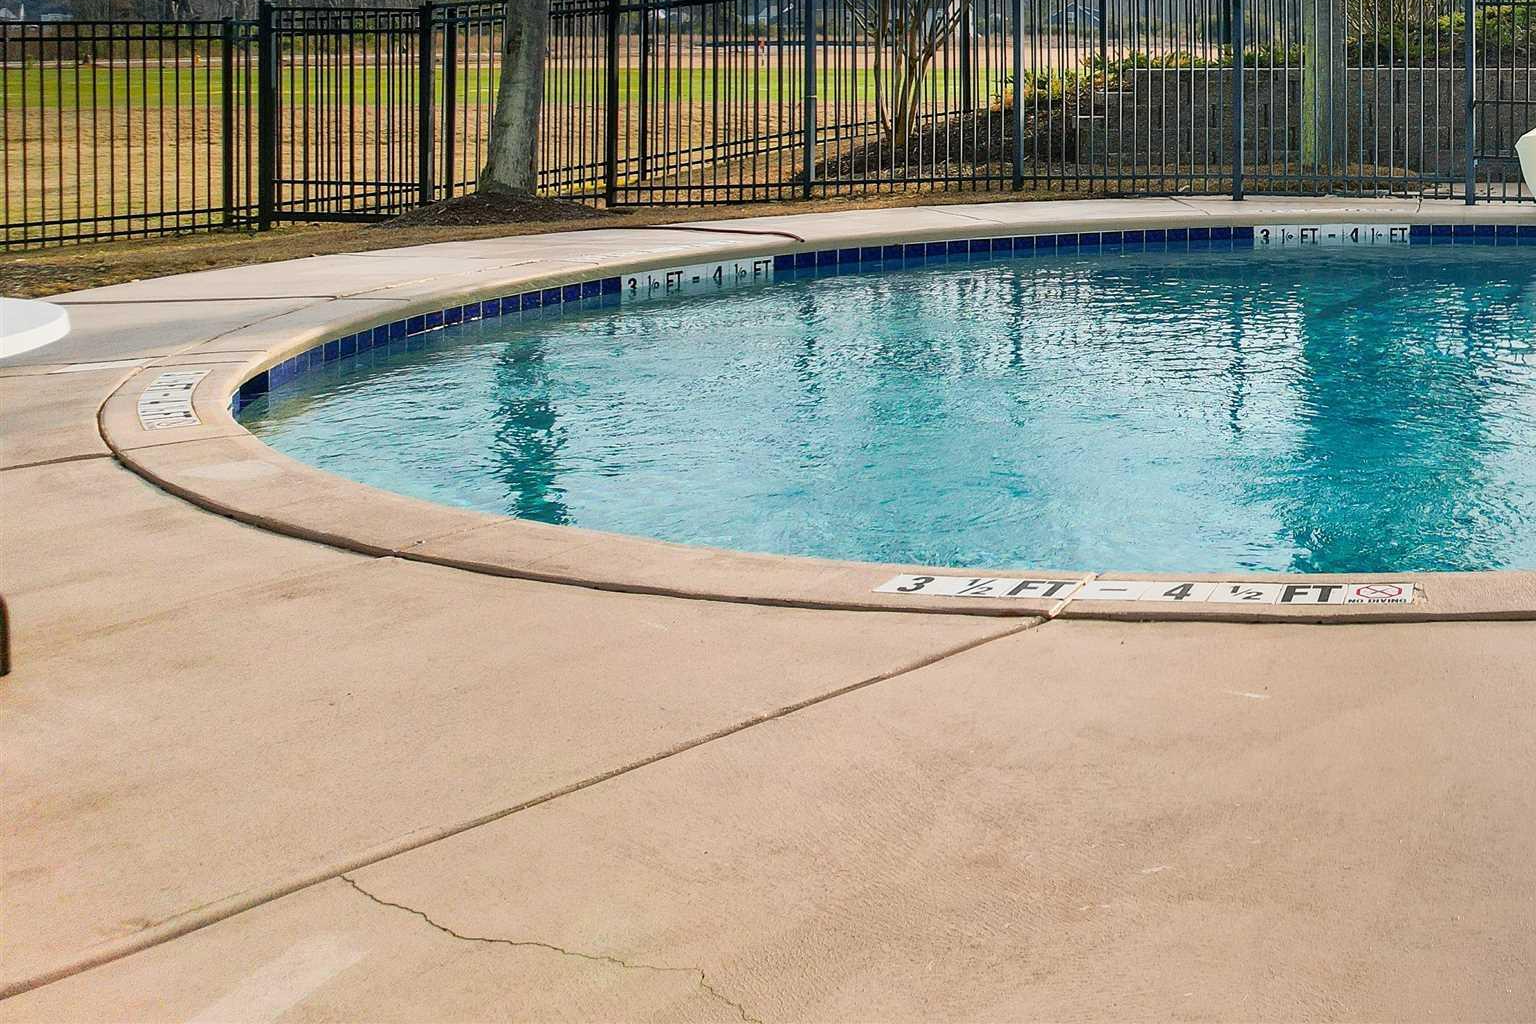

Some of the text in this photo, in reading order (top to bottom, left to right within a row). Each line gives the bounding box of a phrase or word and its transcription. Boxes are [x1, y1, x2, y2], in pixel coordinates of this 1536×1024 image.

[897, 576, 935, 592] 3
[1006, 579, 1078, 597] FT
[1163, 583, 1195, 600] 4
[1280, 584, 1343, 603] FT
